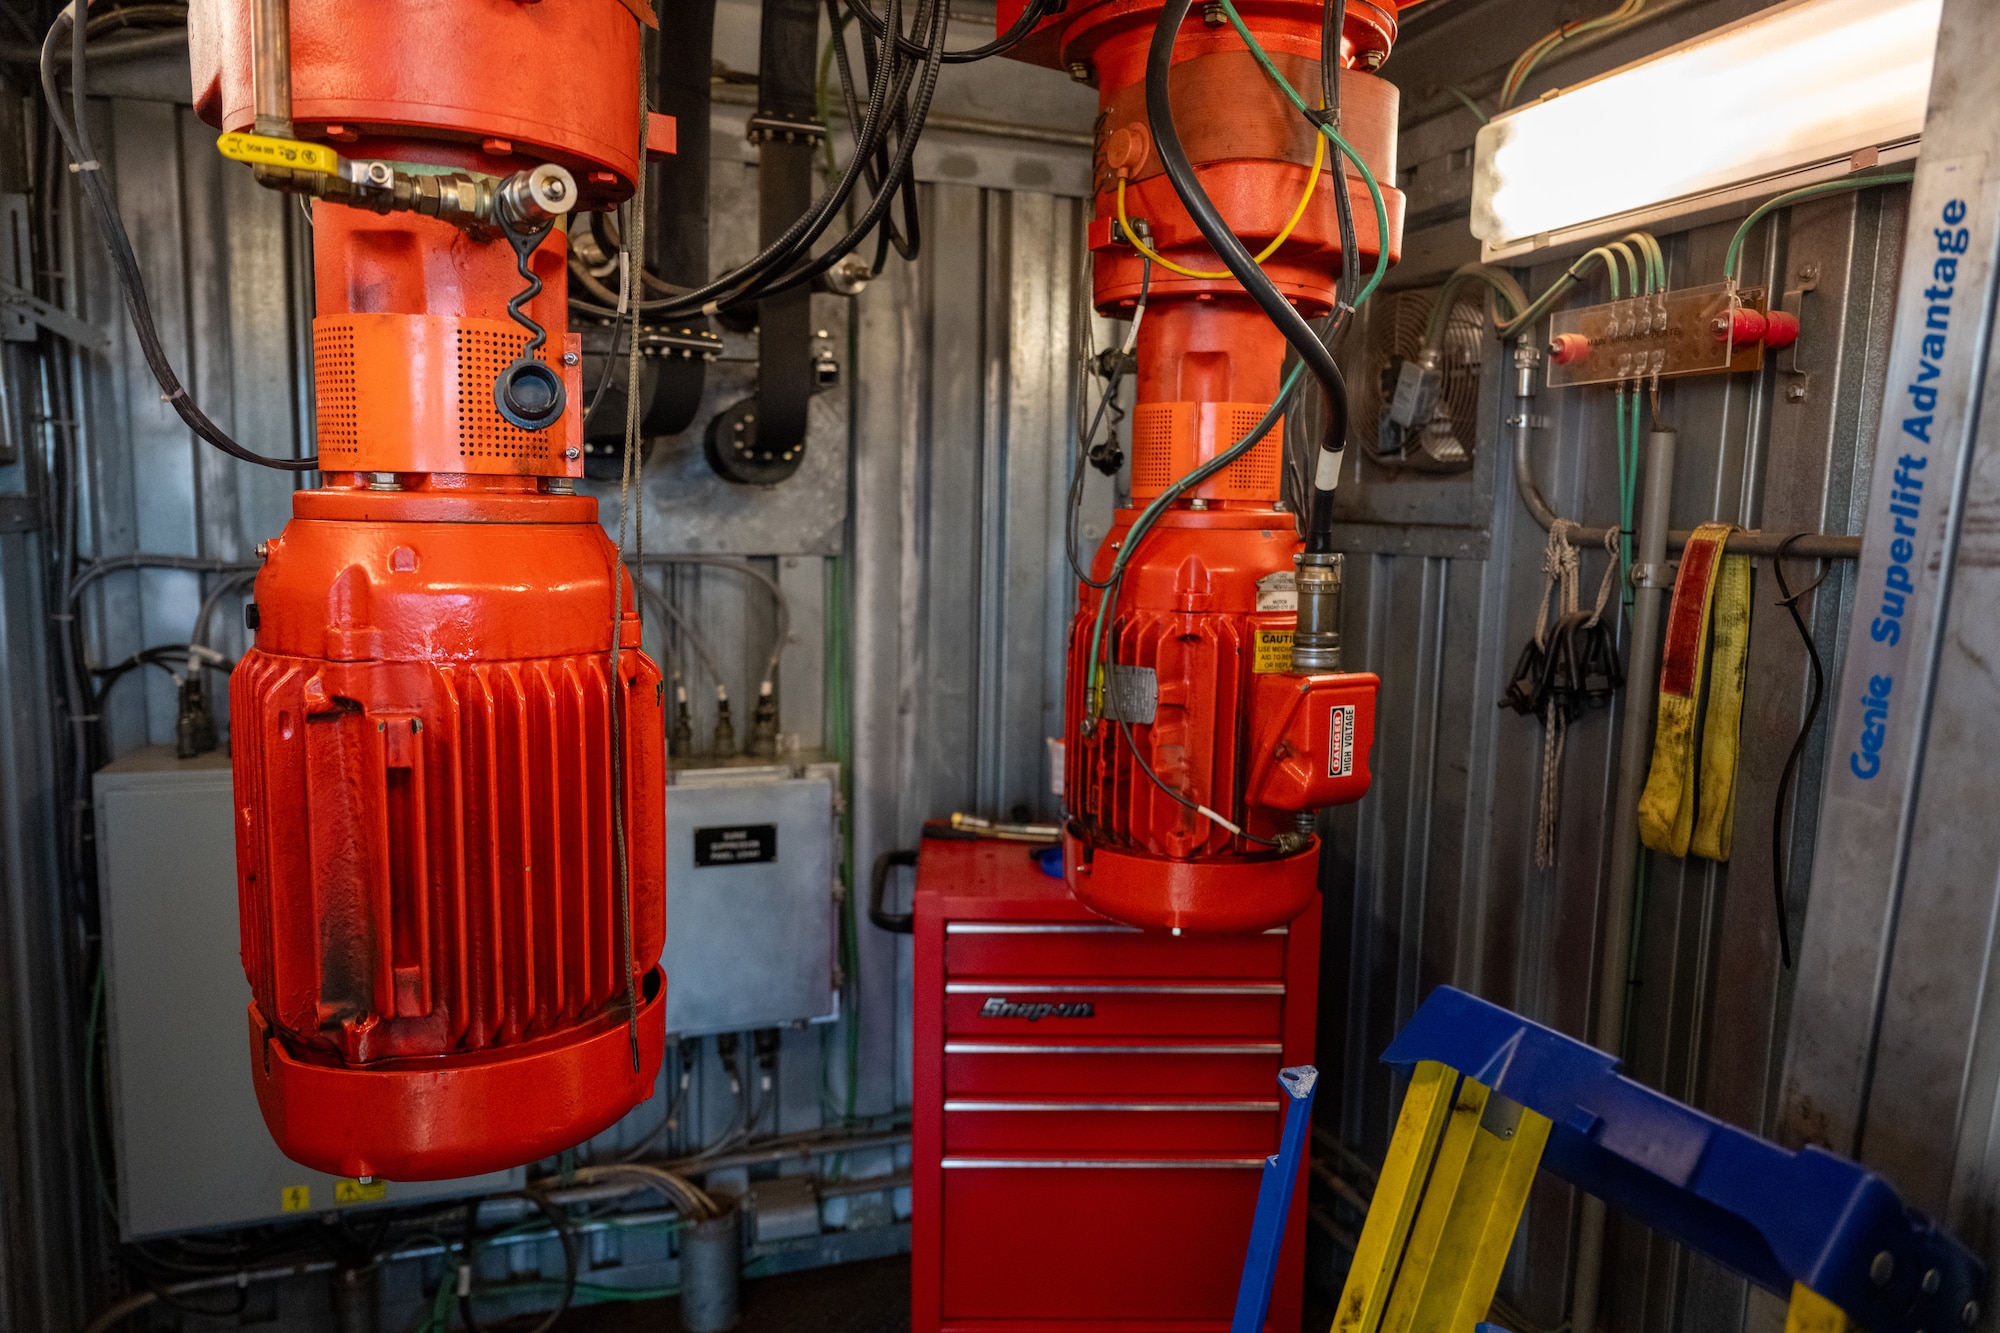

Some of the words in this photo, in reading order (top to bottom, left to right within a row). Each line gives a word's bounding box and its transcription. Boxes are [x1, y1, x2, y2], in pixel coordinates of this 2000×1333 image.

[1902, 198, 1969, 444] Advantage
[1871, 454, 1927, 647] Superlift
[1262, 634, 1292, 644] CAUTI
[1333, 716, 1342, 768] DANGER
[1344, 709, 1354, 747] VOLTAGE
[1850, 674, 1893, 780] Genie
[1343, 751, 1352, 772] HIGH
[979, 997, 1095, 1021] Snap-on
